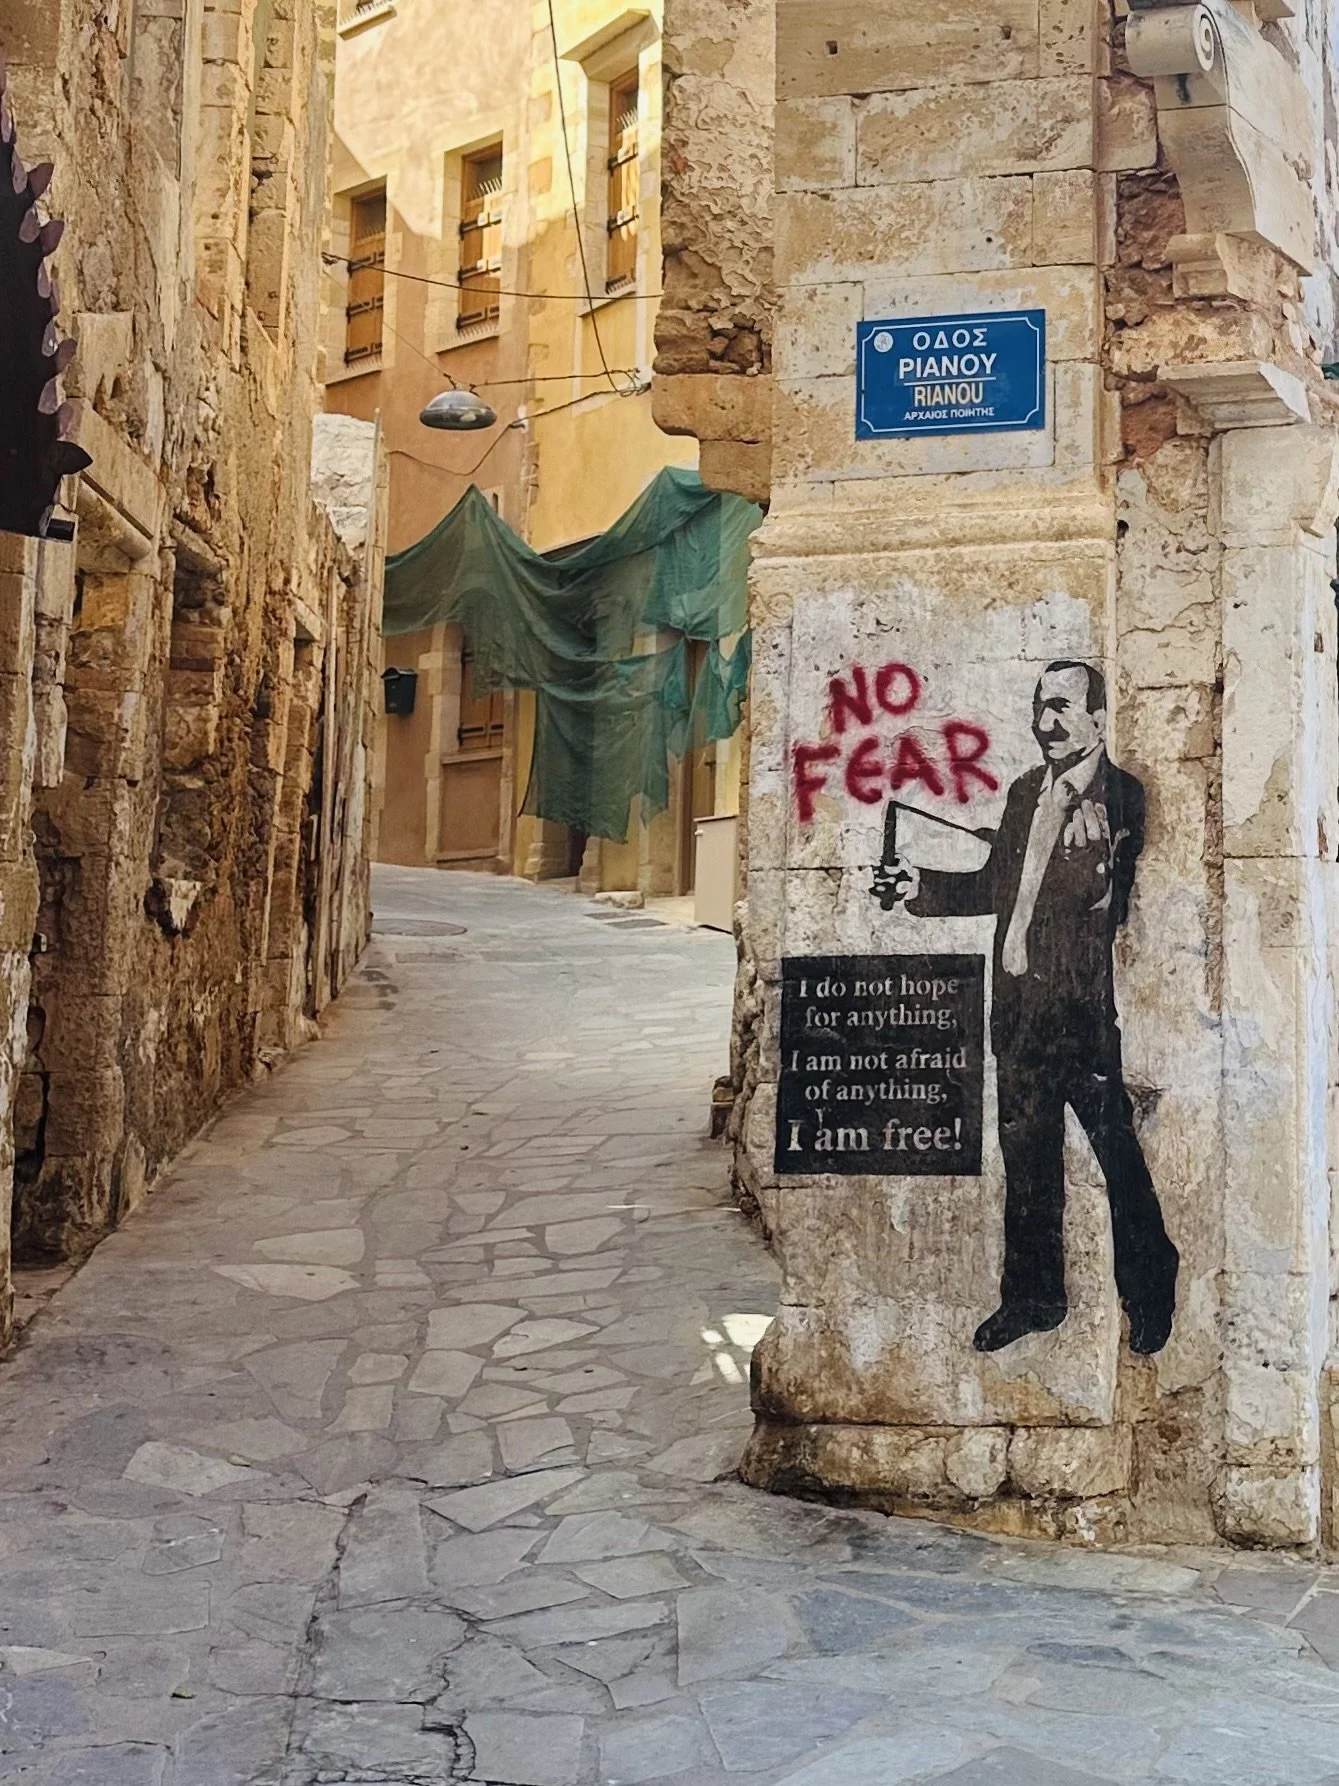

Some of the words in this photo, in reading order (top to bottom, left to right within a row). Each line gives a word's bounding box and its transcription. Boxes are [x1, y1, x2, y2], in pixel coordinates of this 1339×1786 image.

[912, 328, 988, 351] ΟΔΟΣ
[899, 353, 997, 380] ΡΙΑΝΟΥ
[914, 383, 984, 407] RIANOU
[903, 409, 949, 421] ΑΡΧΑΙΟΣ
[950, 407, 995, 419] ΠΟΙΗΤΗΣ
[829, 662, 922, 733] NO
[793, 721, 999, 823] FEAR
[799, 979, 808, 998] I
[816, 976, 847, 998] do
[853, 977, 894, 997] not
[900, 974, 961, 1000] hope
[805, 1006, 841, 1028] for
[846, 1004, 958, 1031] anything,
[790, 1050, 800, 1071] I
[805, 1054, 842, 1071] am
[850, 1051, 889, 1070] not
[895, 1047, 967, 1069] afraid
[805, 1079, 833, 1101] of
[835, 1078, 948, 1105] anything,
[787, 1119, 804, 1151] I
[814, 1125, 870, 1151] am
[883, 1117, 963, 1151] free!
